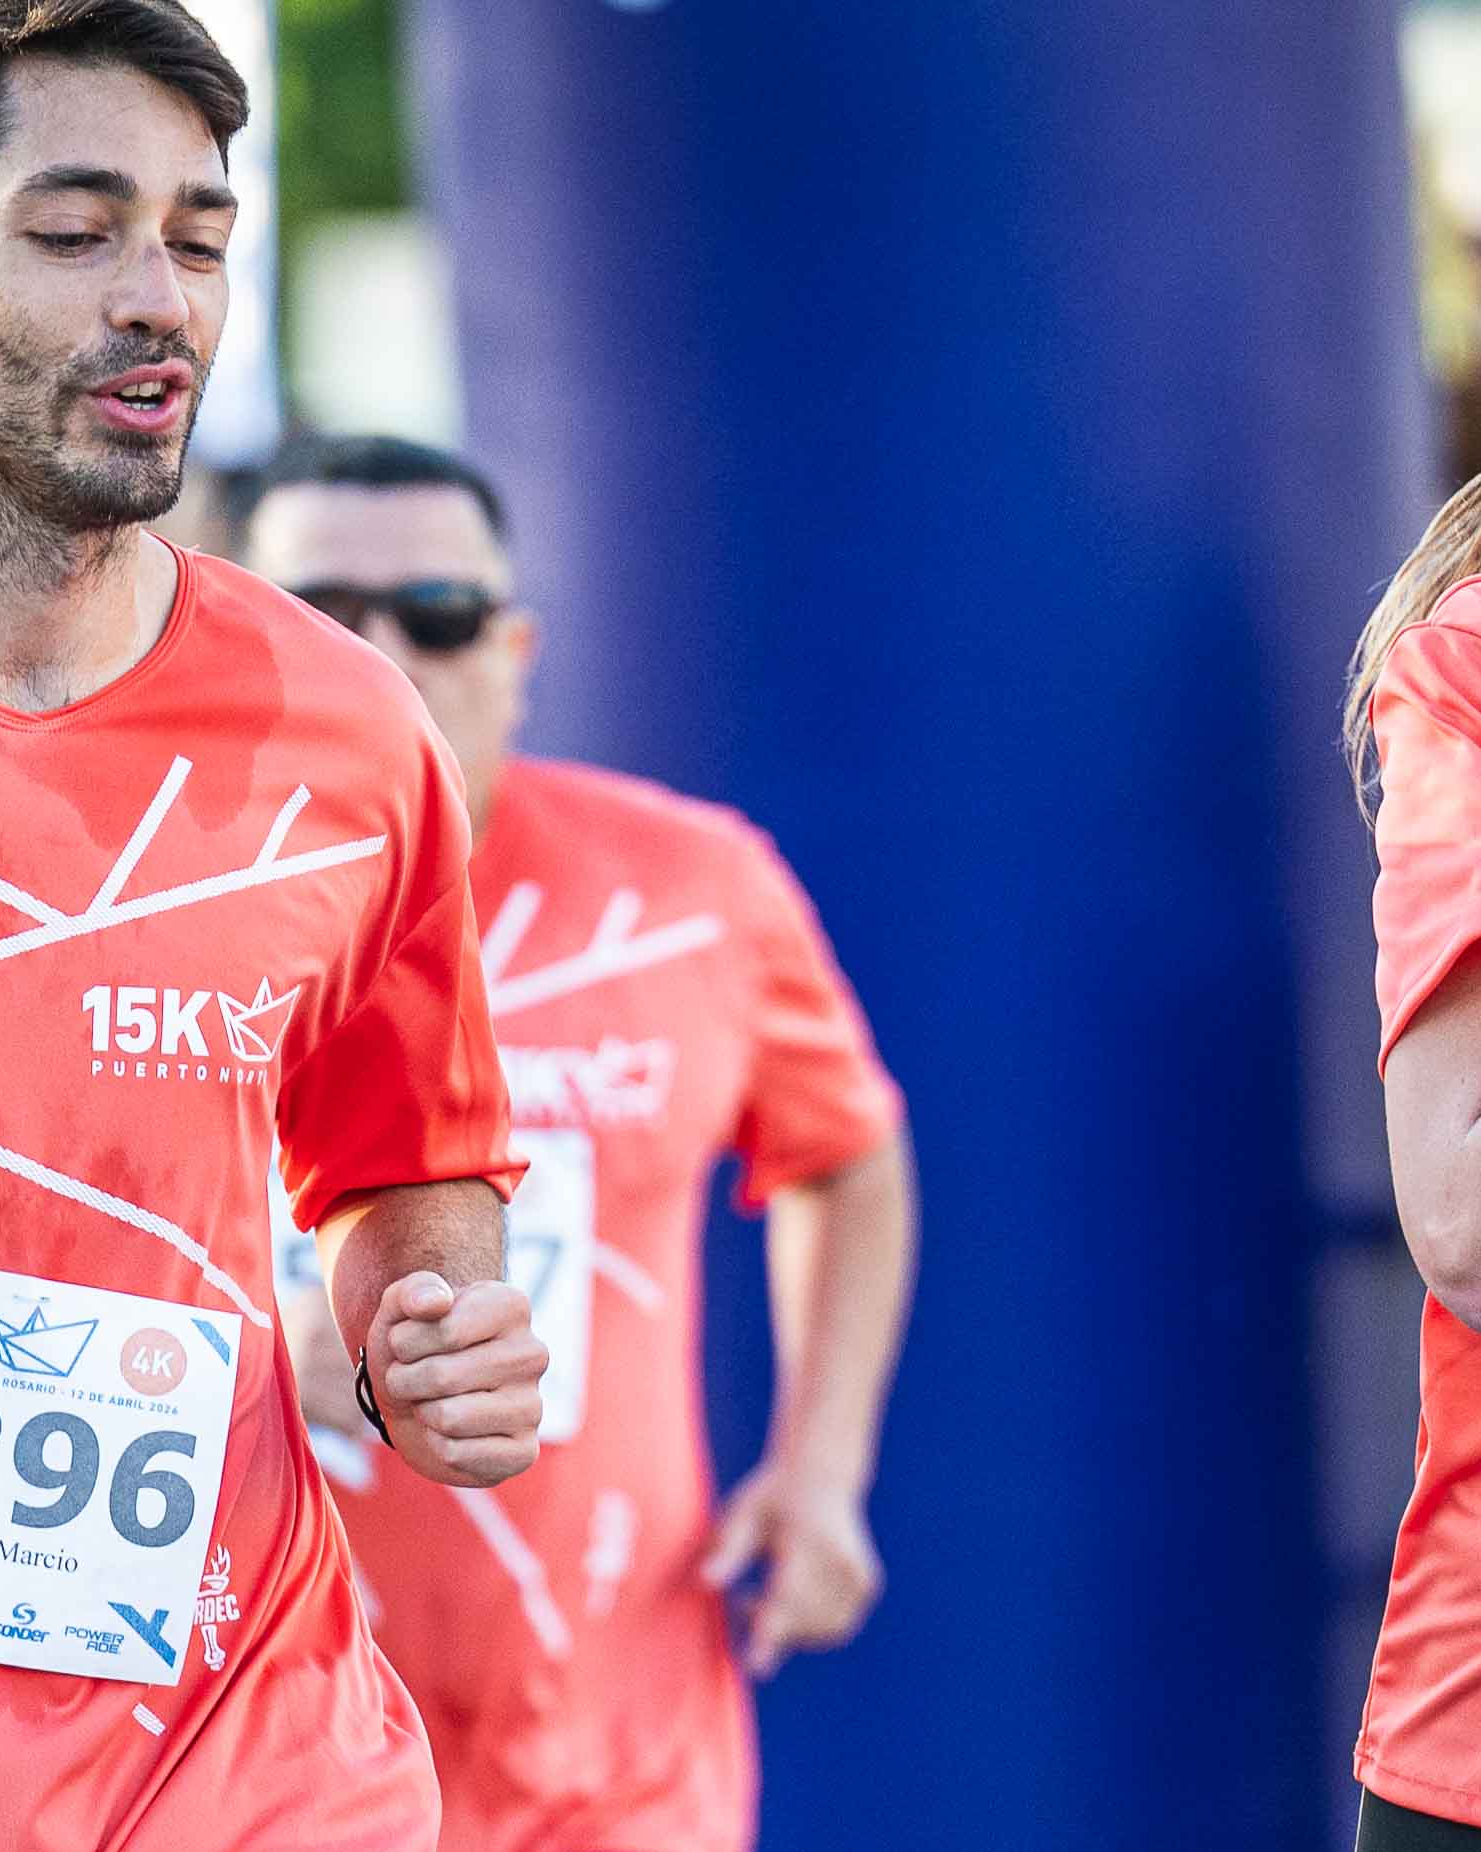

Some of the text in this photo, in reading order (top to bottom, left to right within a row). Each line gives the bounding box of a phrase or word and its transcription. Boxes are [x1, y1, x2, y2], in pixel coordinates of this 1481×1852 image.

[82, 985, 212, 1056] 15K
[91, 1060, 207, 1080] PUERTO
[132, 1343, 174, 1377] 4K
[2, 1377, 56, 1395] ROSARIO
[71, 1389, 84, 1400] 12
[89, 1393, 104, 1403] DE
[109, 1396, 144, 1410] ABRIL
[65, 1625, 125, 1644] POWER
[86, 1639, 120, 1655] ADE
